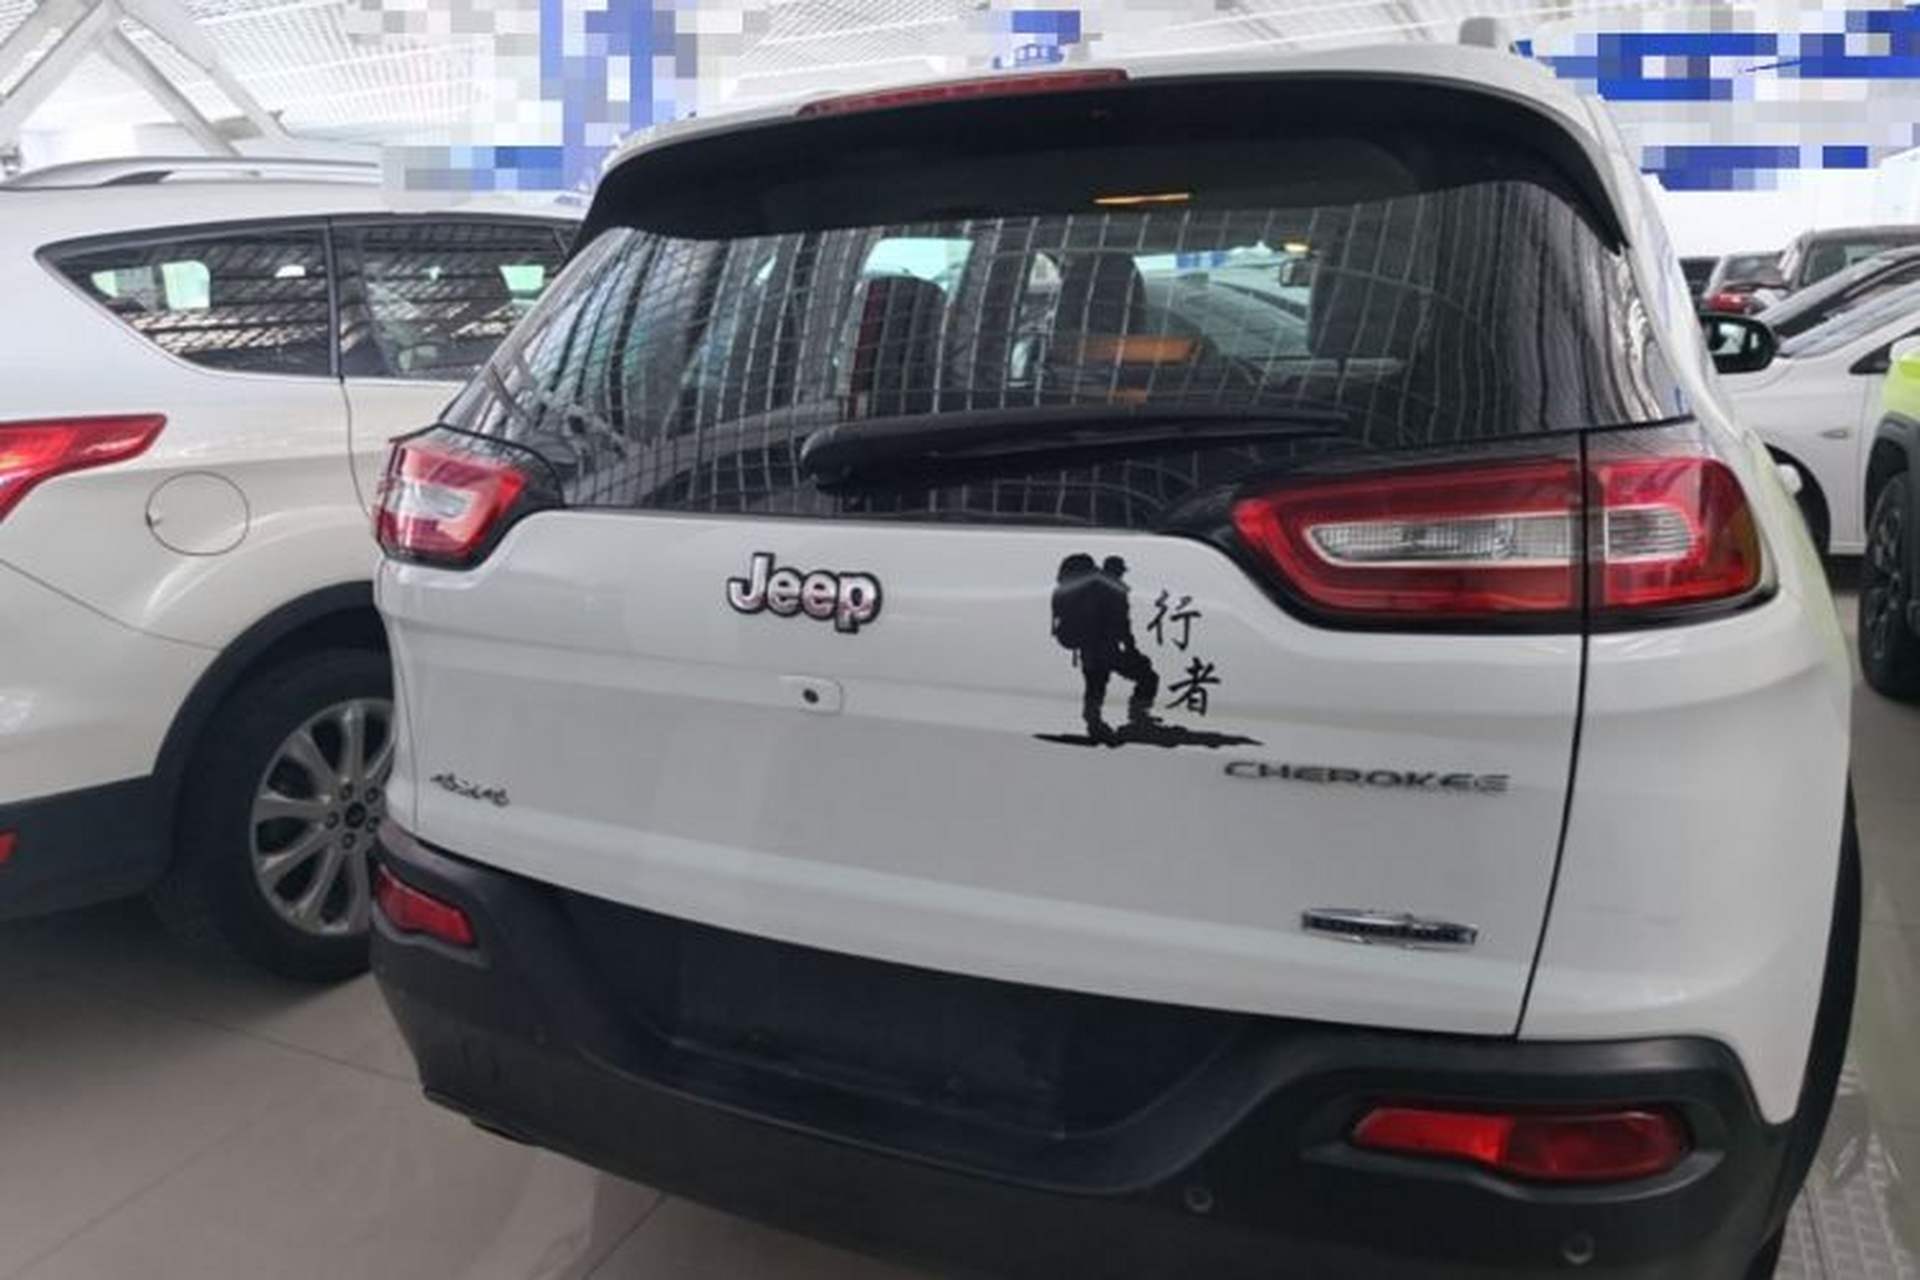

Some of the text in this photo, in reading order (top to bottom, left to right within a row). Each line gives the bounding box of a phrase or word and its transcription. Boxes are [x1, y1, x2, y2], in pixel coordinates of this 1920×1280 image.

[726, 552, 883, 634] Jeep
[1147, 589, 1222, 717] 行者
[1224, 760, 1510, 793] CHEROKEE
